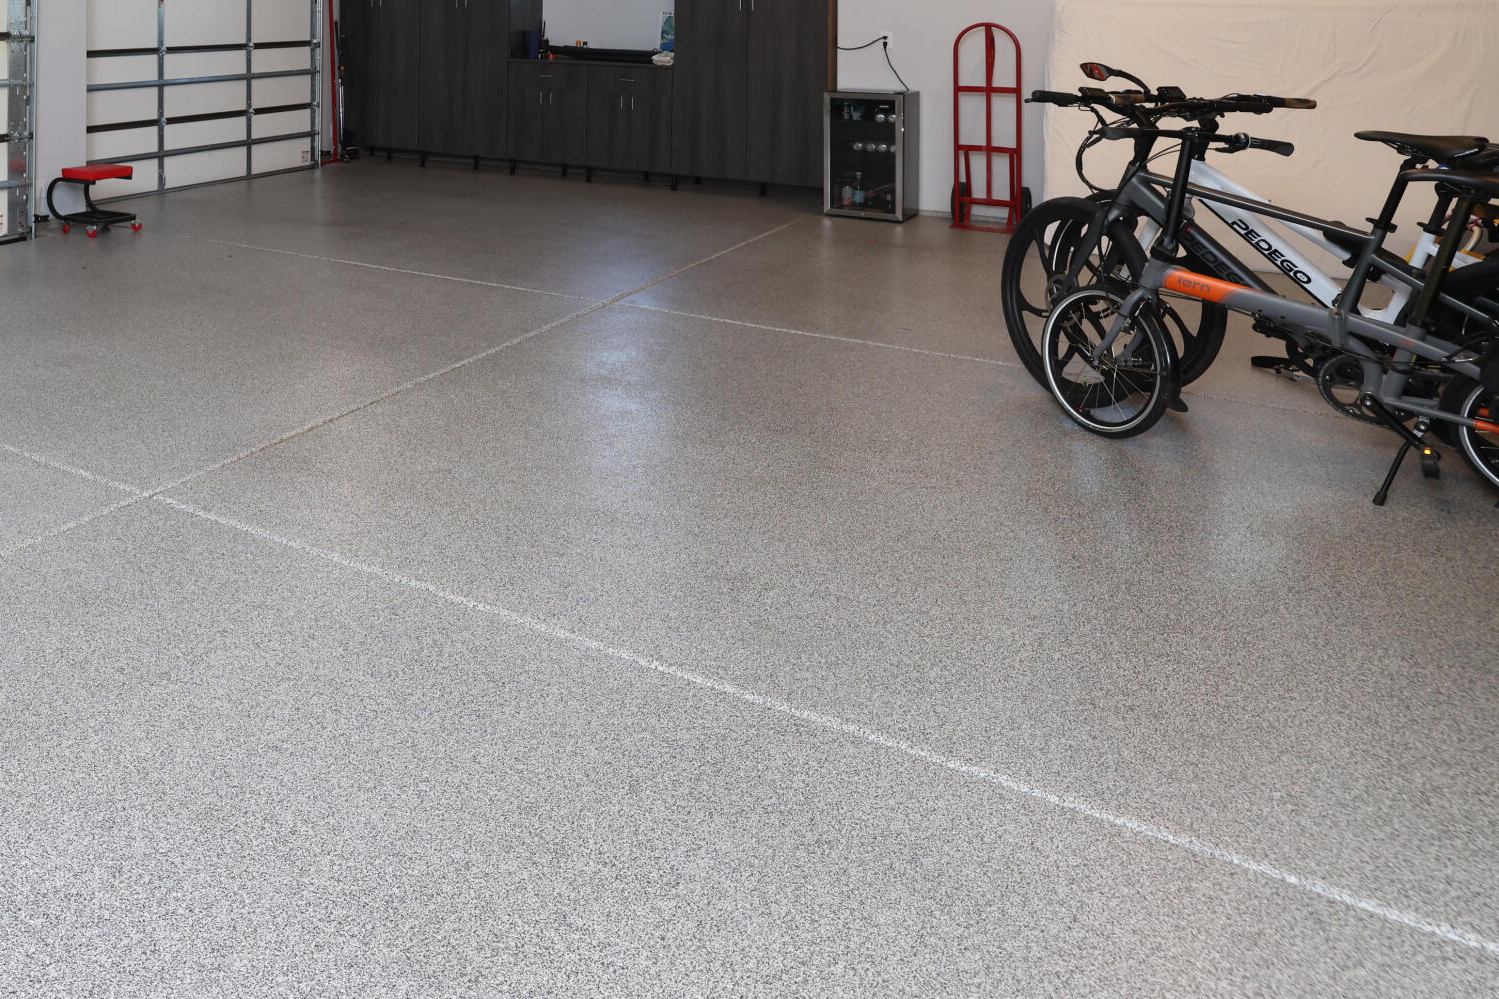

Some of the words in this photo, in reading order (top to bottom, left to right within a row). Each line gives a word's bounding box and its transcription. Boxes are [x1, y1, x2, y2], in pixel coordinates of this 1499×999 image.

[1180, 230, 1245, 282] PEDEG
[1231, 218, 1312, 285] PEDEGO
[1177, 276, 1211, 293] tern
